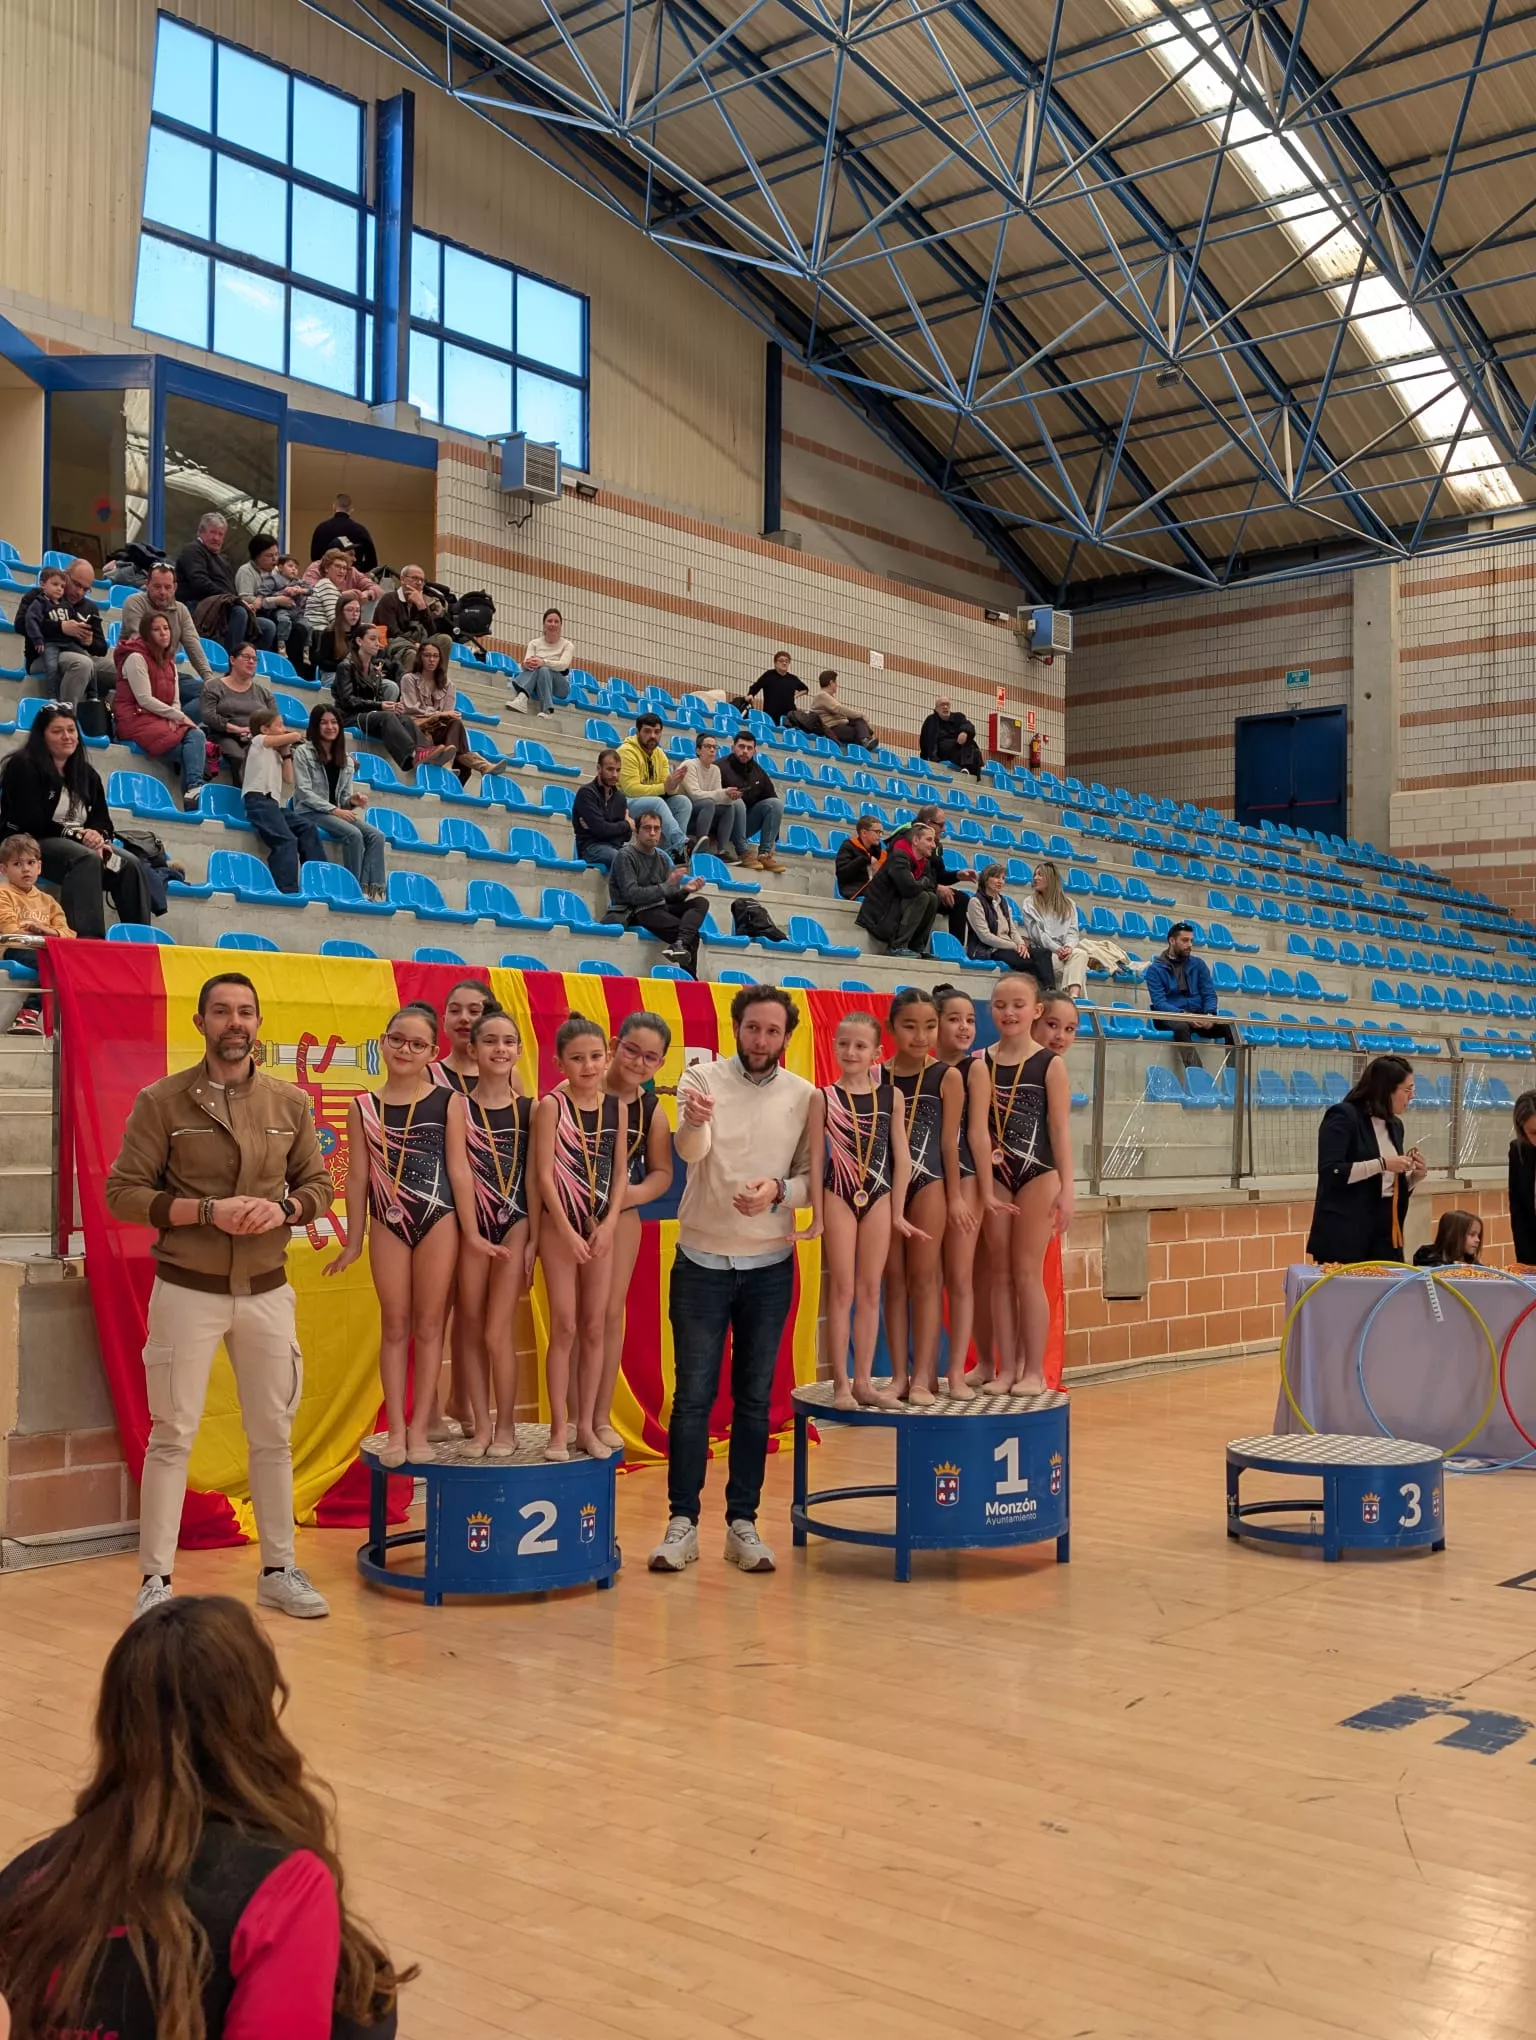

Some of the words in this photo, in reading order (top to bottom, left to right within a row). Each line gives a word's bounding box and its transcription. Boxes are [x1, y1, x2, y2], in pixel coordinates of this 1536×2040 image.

[994, 1437, 1028, 1495] 1
[985, 1498, 1037, 1516] Monzón
[985, 1512, 1037, 1526] Ayuntamiento
[1399, 1483, 1422, 1527] 3
[517, 1500, 558, 1555] 2
